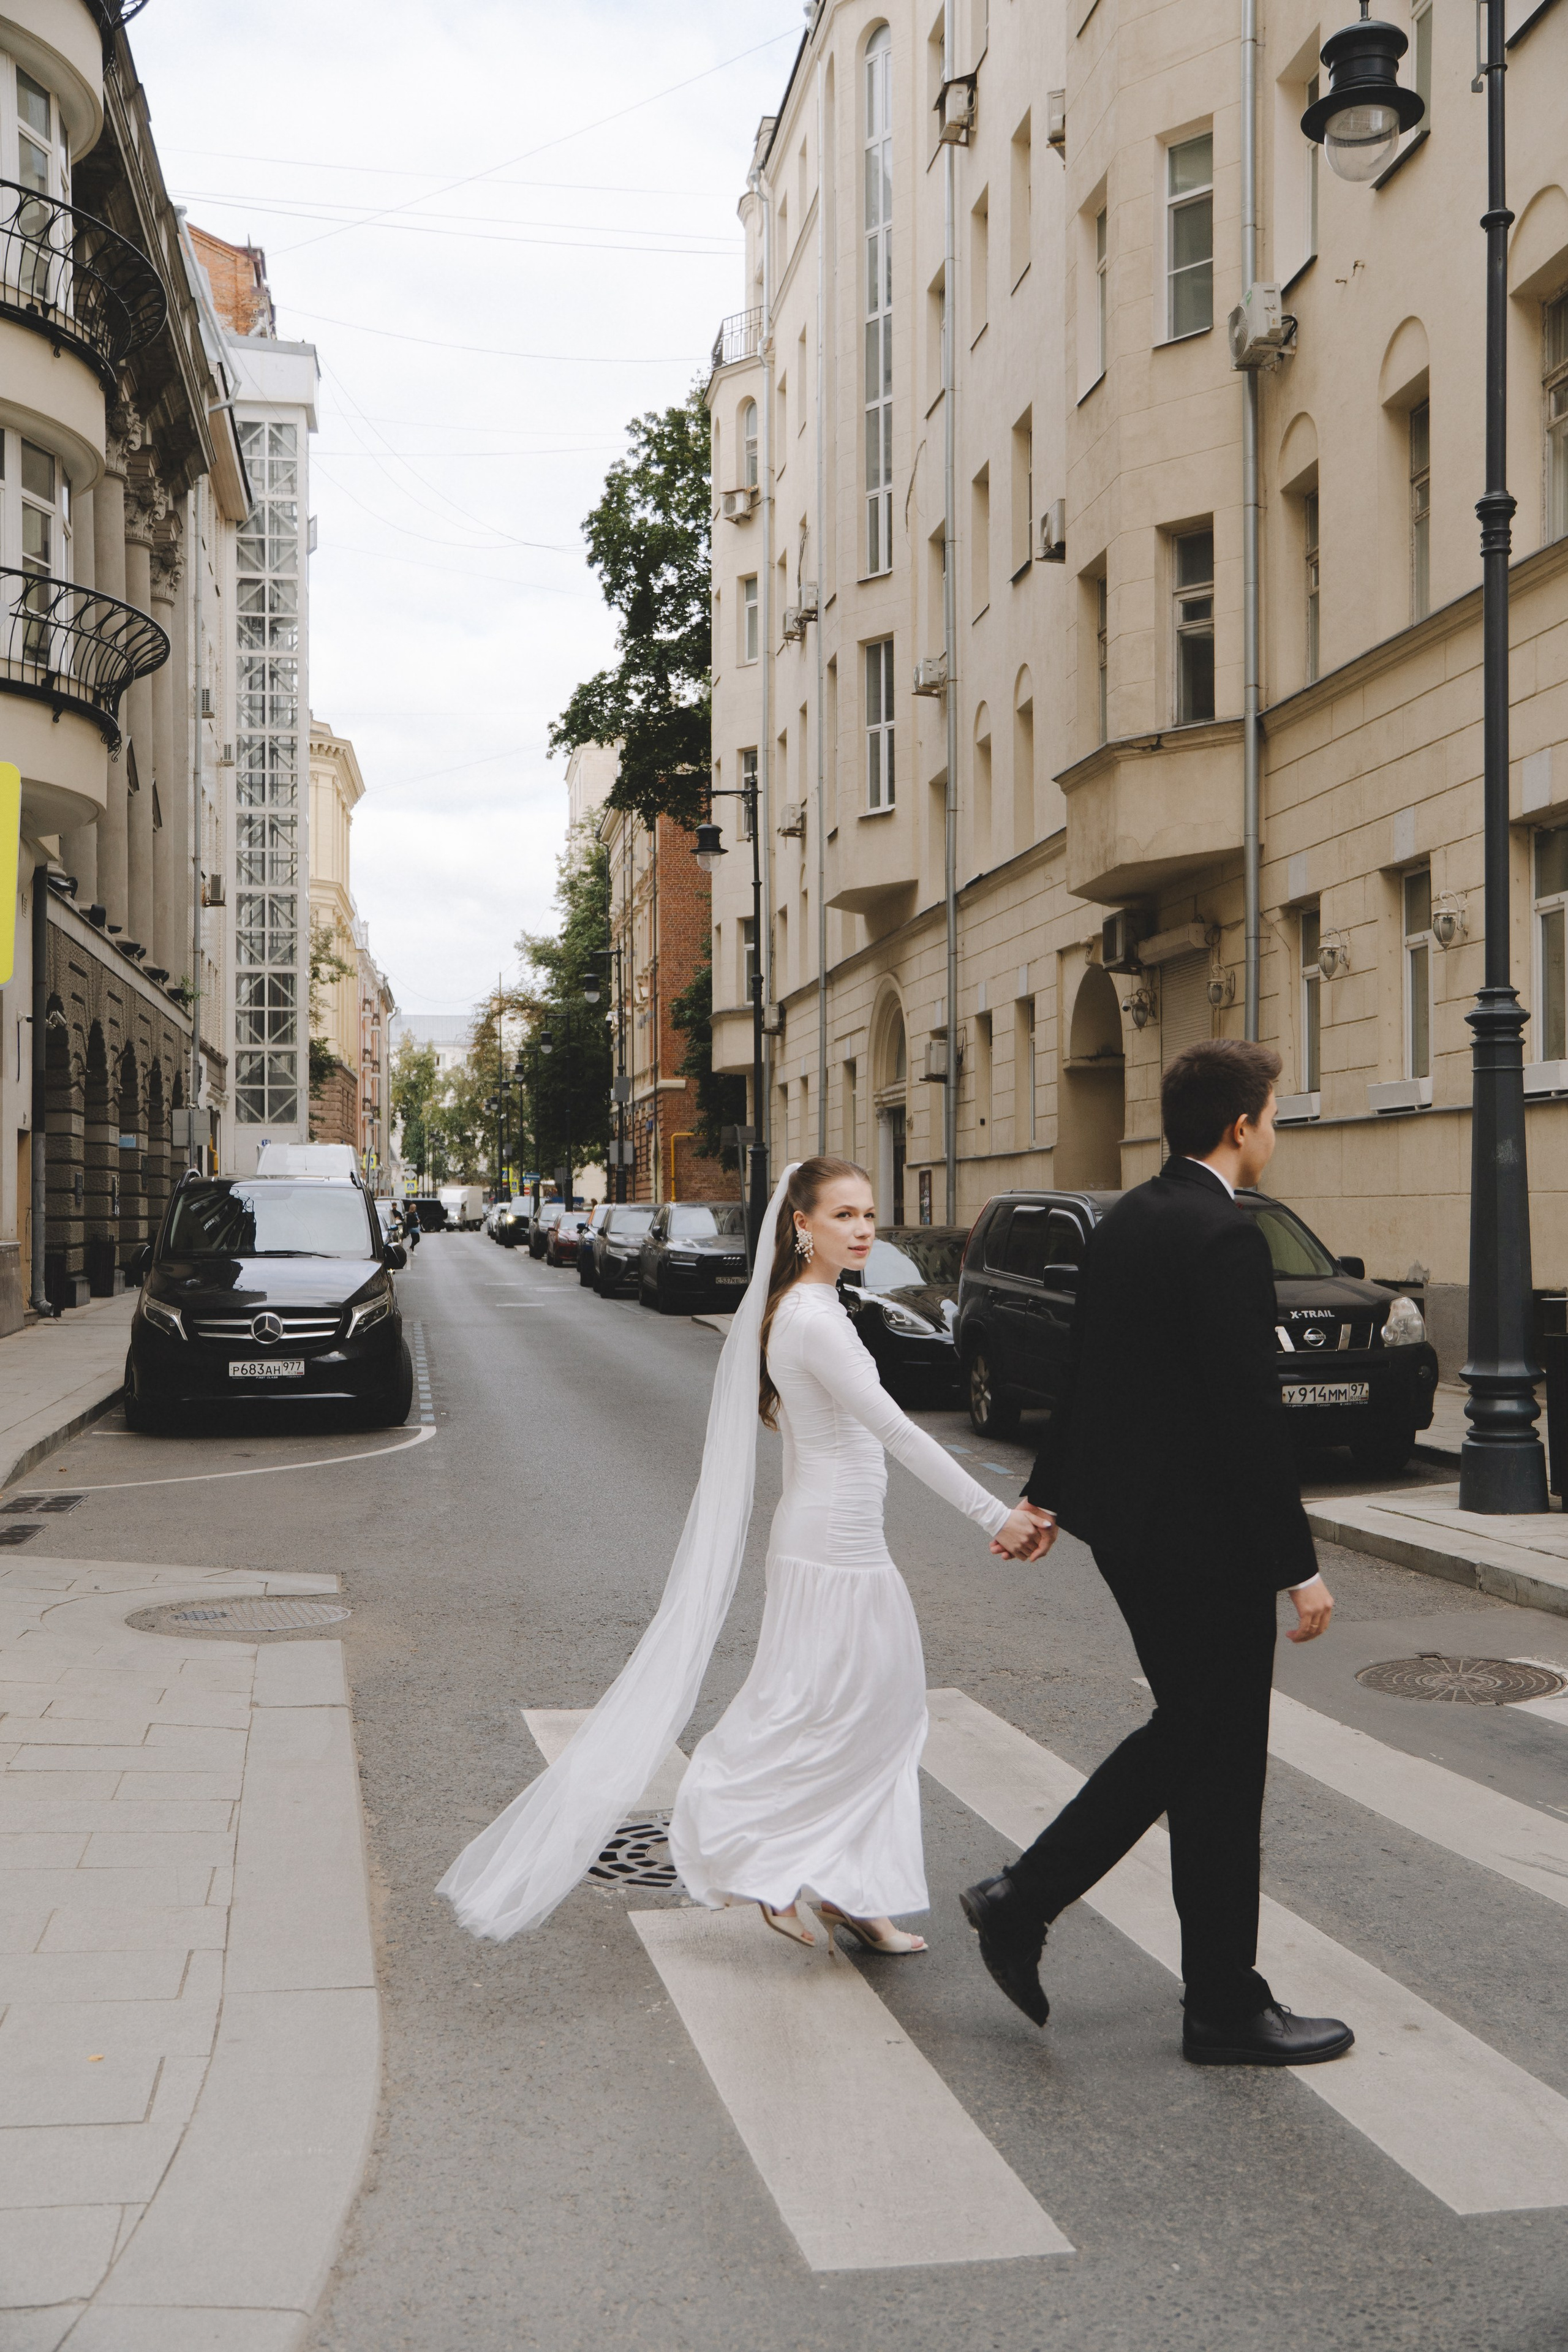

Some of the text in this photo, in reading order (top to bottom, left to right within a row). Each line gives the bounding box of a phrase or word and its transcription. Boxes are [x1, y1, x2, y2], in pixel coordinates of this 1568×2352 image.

[1290, 1310, 1335, 1319] X-TRAIL
[283, 1362, 301, 1371] 977
[1351, 1383, 1365, 1395] 97
